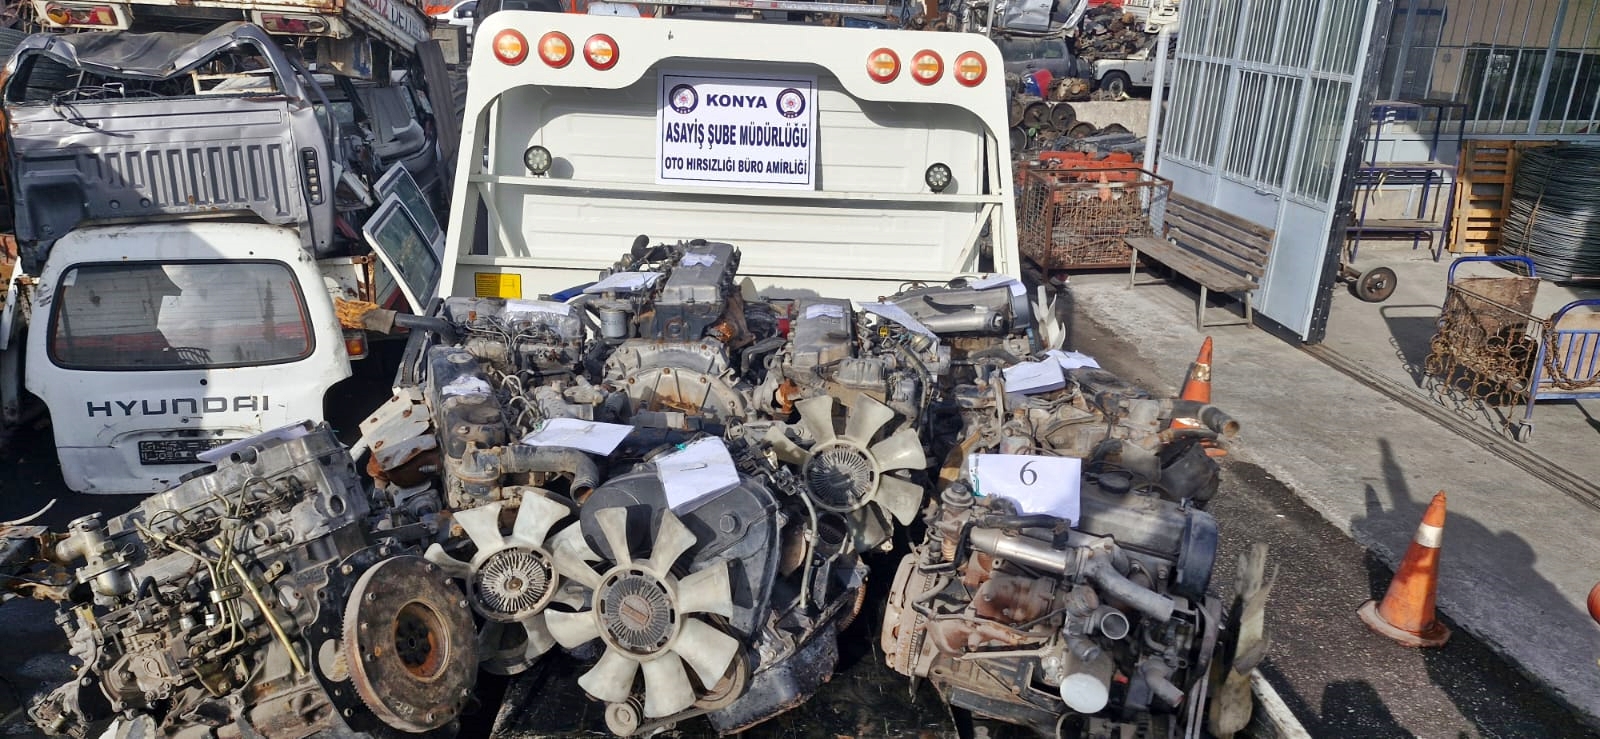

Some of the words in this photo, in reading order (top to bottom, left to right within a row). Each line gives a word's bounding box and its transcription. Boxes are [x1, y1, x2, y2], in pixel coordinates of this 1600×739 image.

[706, 94, 768, 109] KONYA
[666, 118, 705, 150] ASAYİŞ
[708, 122, 736, 150] ŞUBE
[740, 121, 808, 148] MÜDÜRLÜĞÜ
[665, 156, 684, 171] OTO
[686, 156, 735, 173] HIRSIZLIĞI
[738, 157, 764, 173] BÜRO
[766, 159, 807, 175] AMİRLİĞİ
[87, 395, 269, 417] HYUNDAI
[1019, 460, 1038, 486] 6
